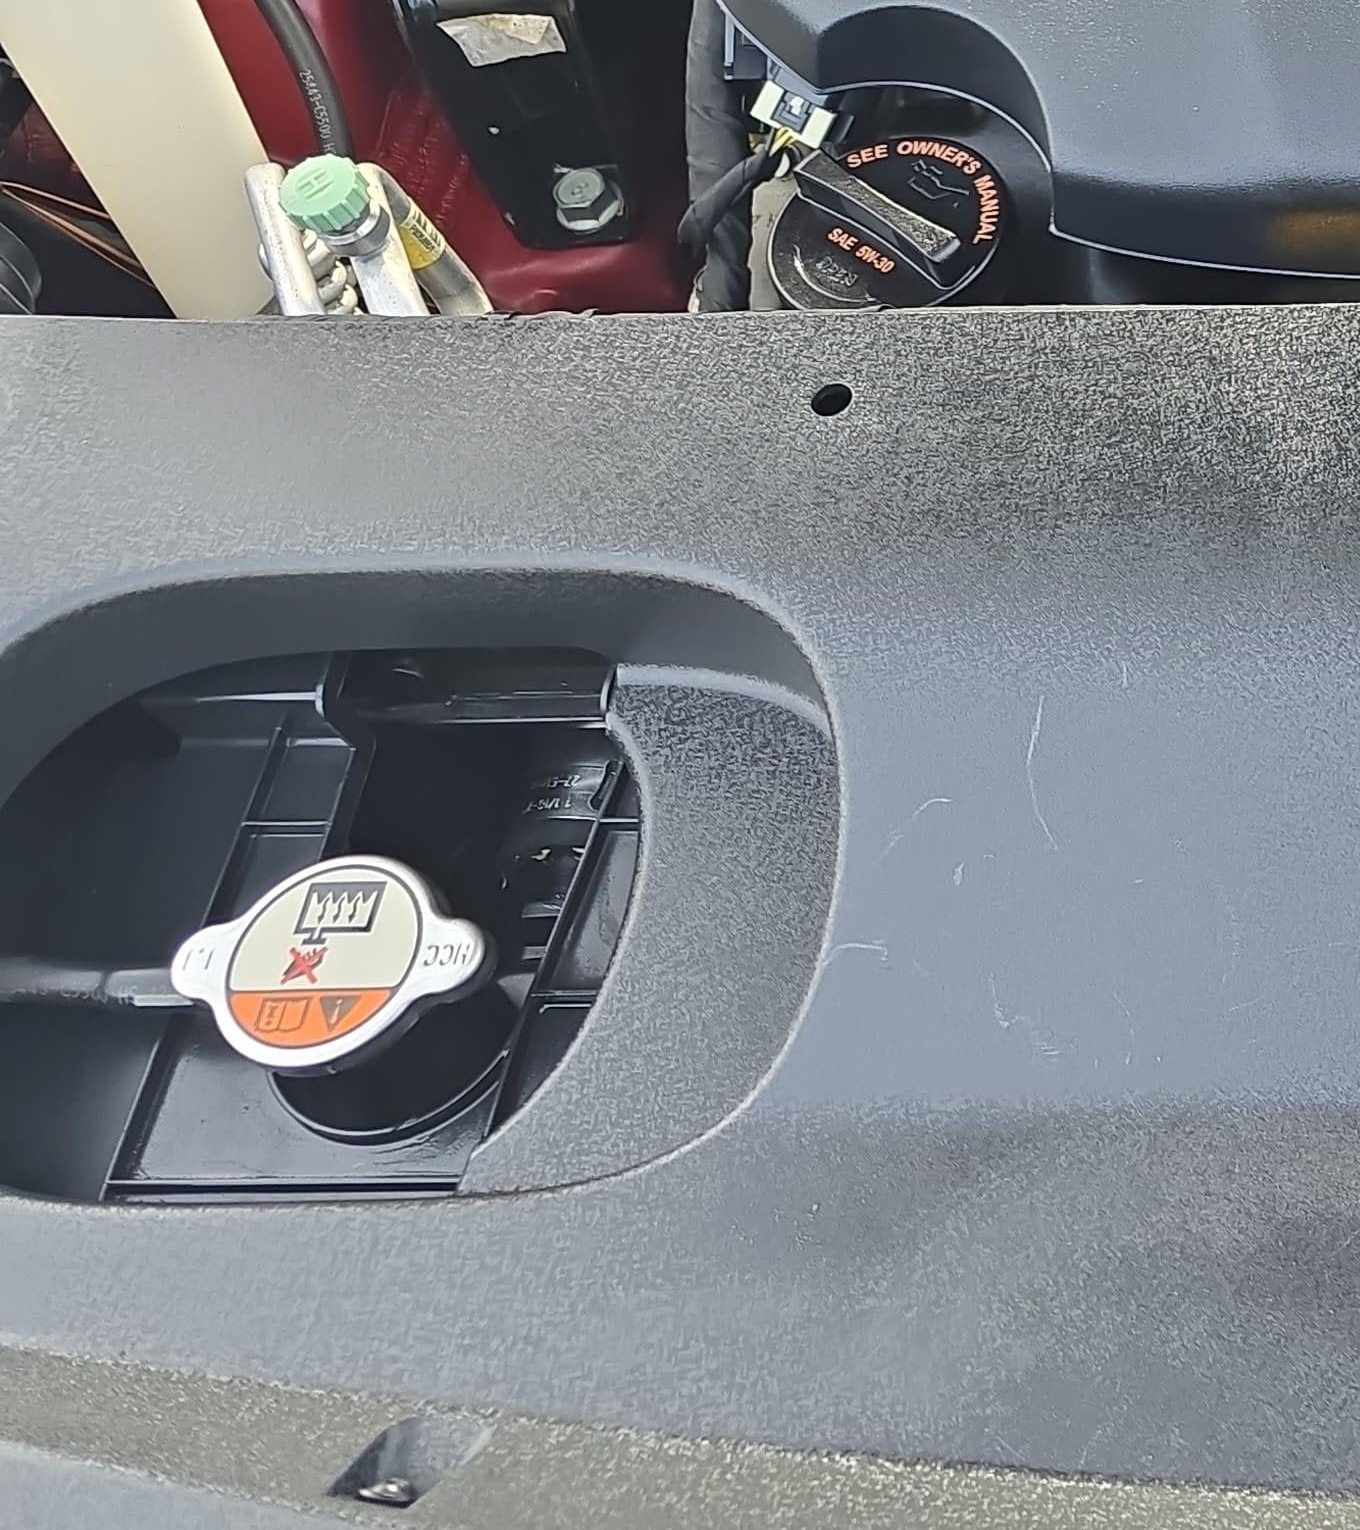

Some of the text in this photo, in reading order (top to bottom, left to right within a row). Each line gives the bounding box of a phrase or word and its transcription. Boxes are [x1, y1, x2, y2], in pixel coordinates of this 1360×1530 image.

[846, 140, 1001, 246] SEE OWNER'S MANUAL
[826, 227, 897, 275] SAE 5W-30
